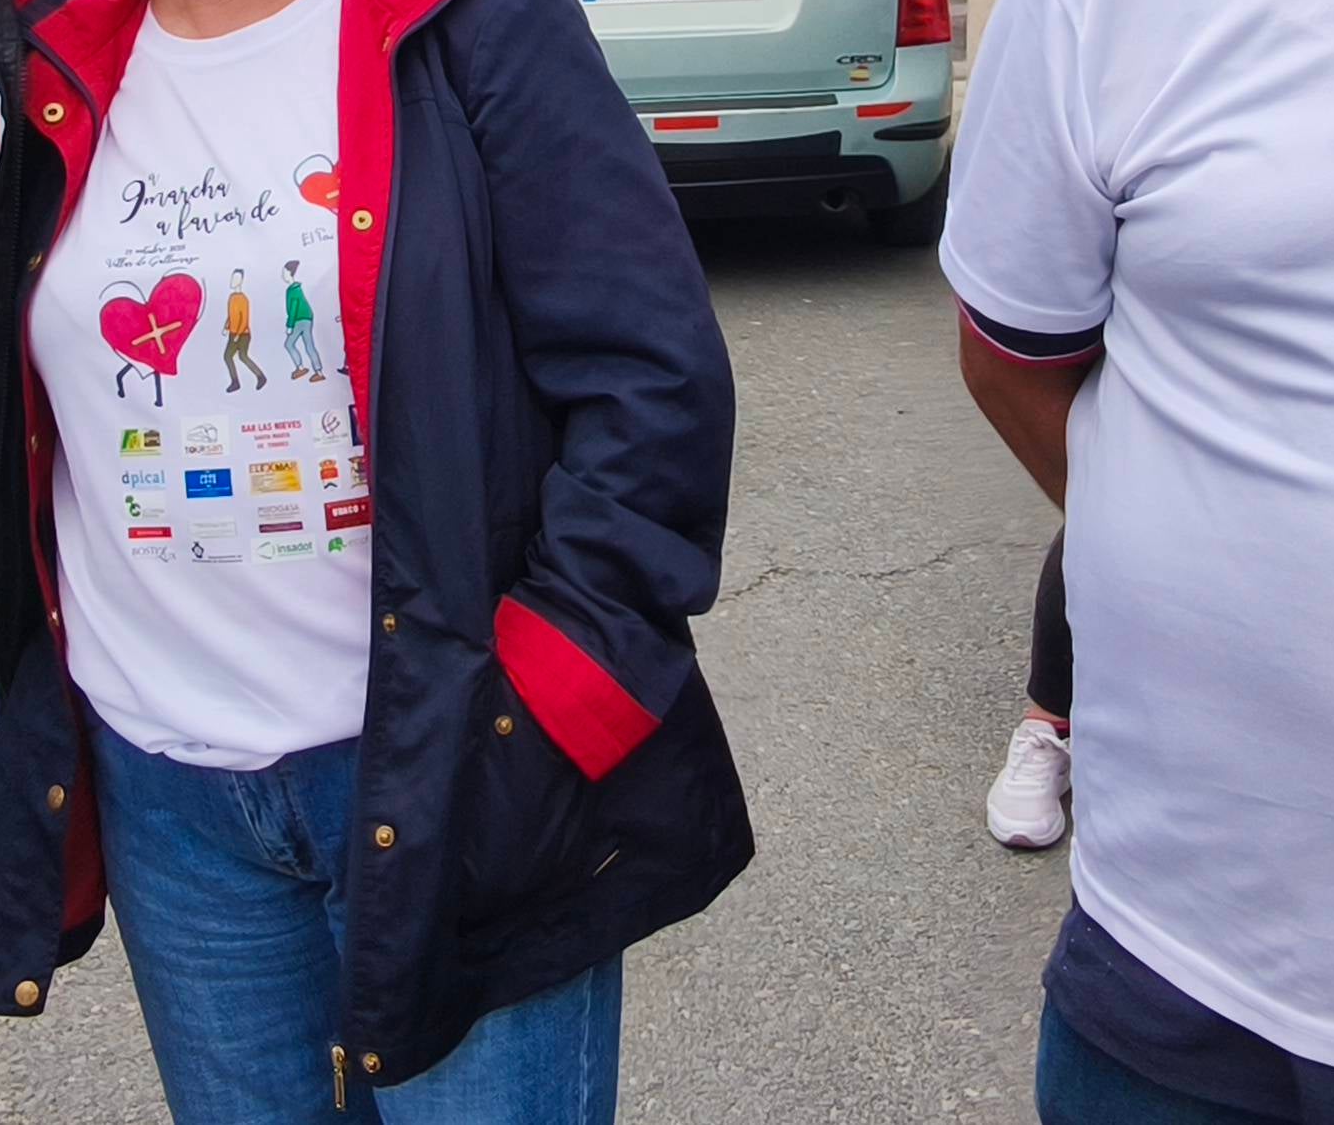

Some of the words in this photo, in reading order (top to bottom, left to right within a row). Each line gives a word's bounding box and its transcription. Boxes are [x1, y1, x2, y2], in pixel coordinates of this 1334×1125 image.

[144, 167, 232, 207] marcha
[156, 220, 172, 236] a
[177, 201, 247, 240] favor
[250, 189, 280, 222] de
[121, 469, 166, 488] dpical
